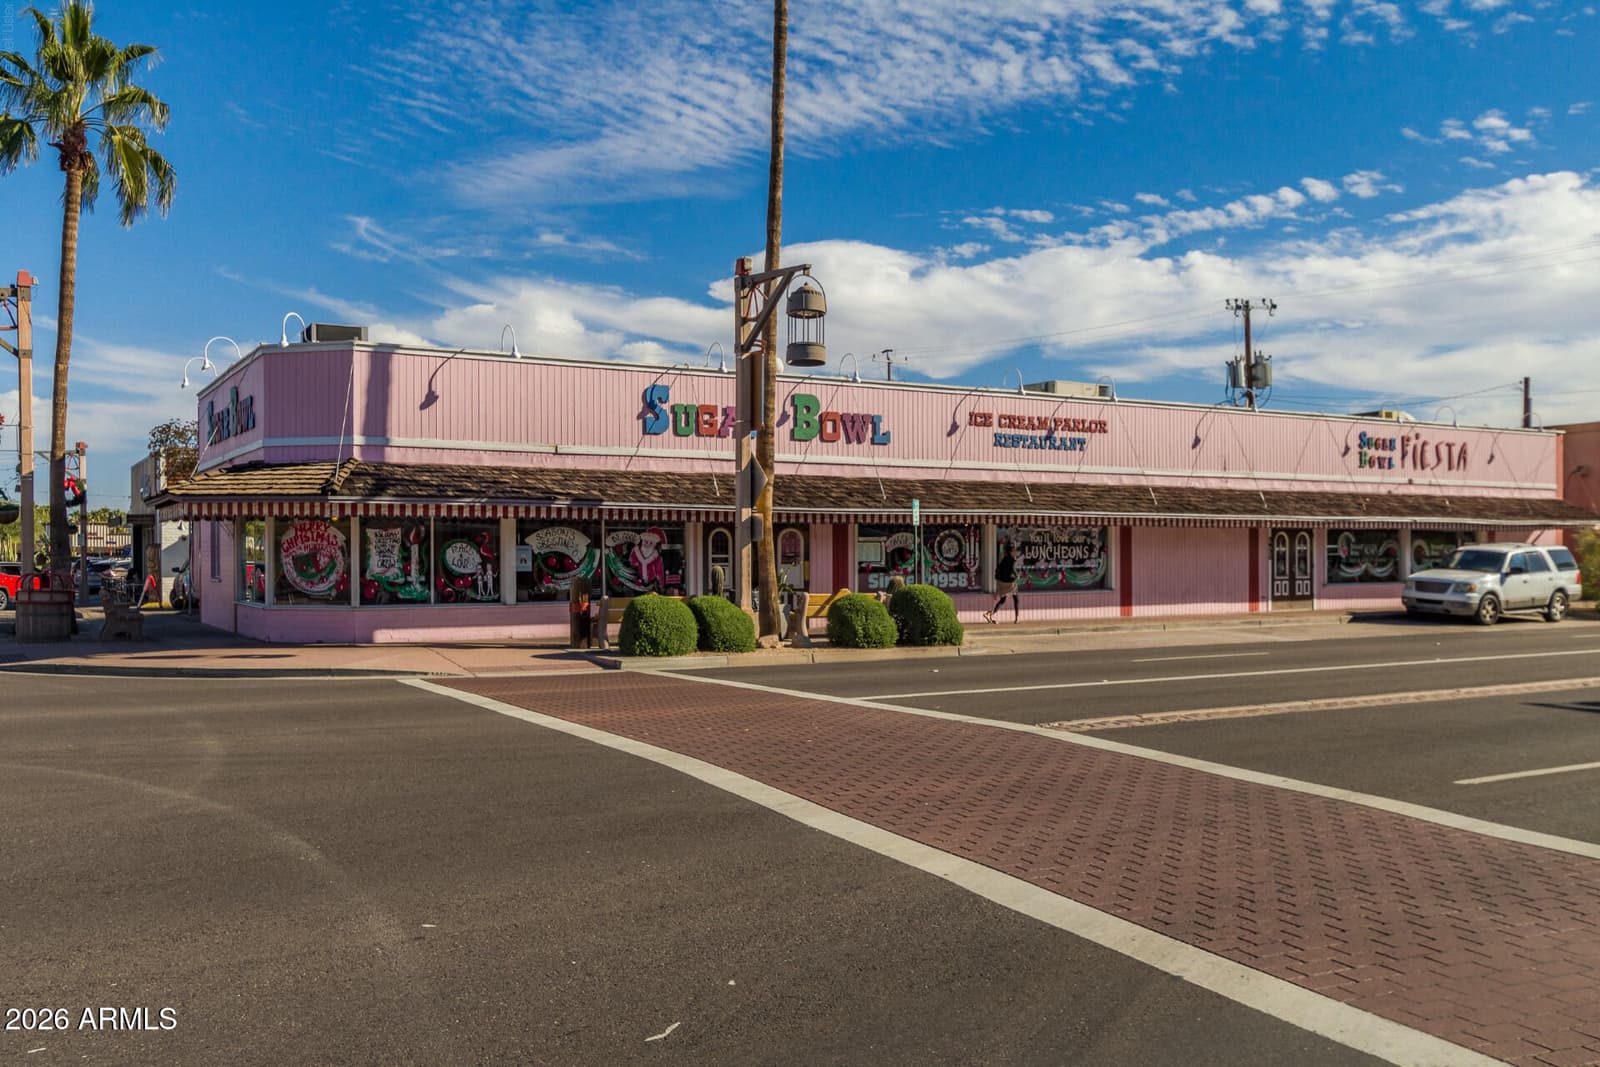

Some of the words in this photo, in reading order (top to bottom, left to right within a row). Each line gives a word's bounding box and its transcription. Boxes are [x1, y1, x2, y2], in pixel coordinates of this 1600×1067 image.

[644, 384, 757, 439] SUGA
[791, 393, 891, 445] BOWL
[968, 411, 993, 428] ICE
[998, 413, 1050, 431] CREAM
[1053, 416, 1109, 434] PARLOR
[993, 432, 1087, 452] RESTAURANT
[1024, 544, 1089, 560] LUNCHEONS
[868, 572, 915, 589] Sine
[932, 572, 968, 588] 1958
